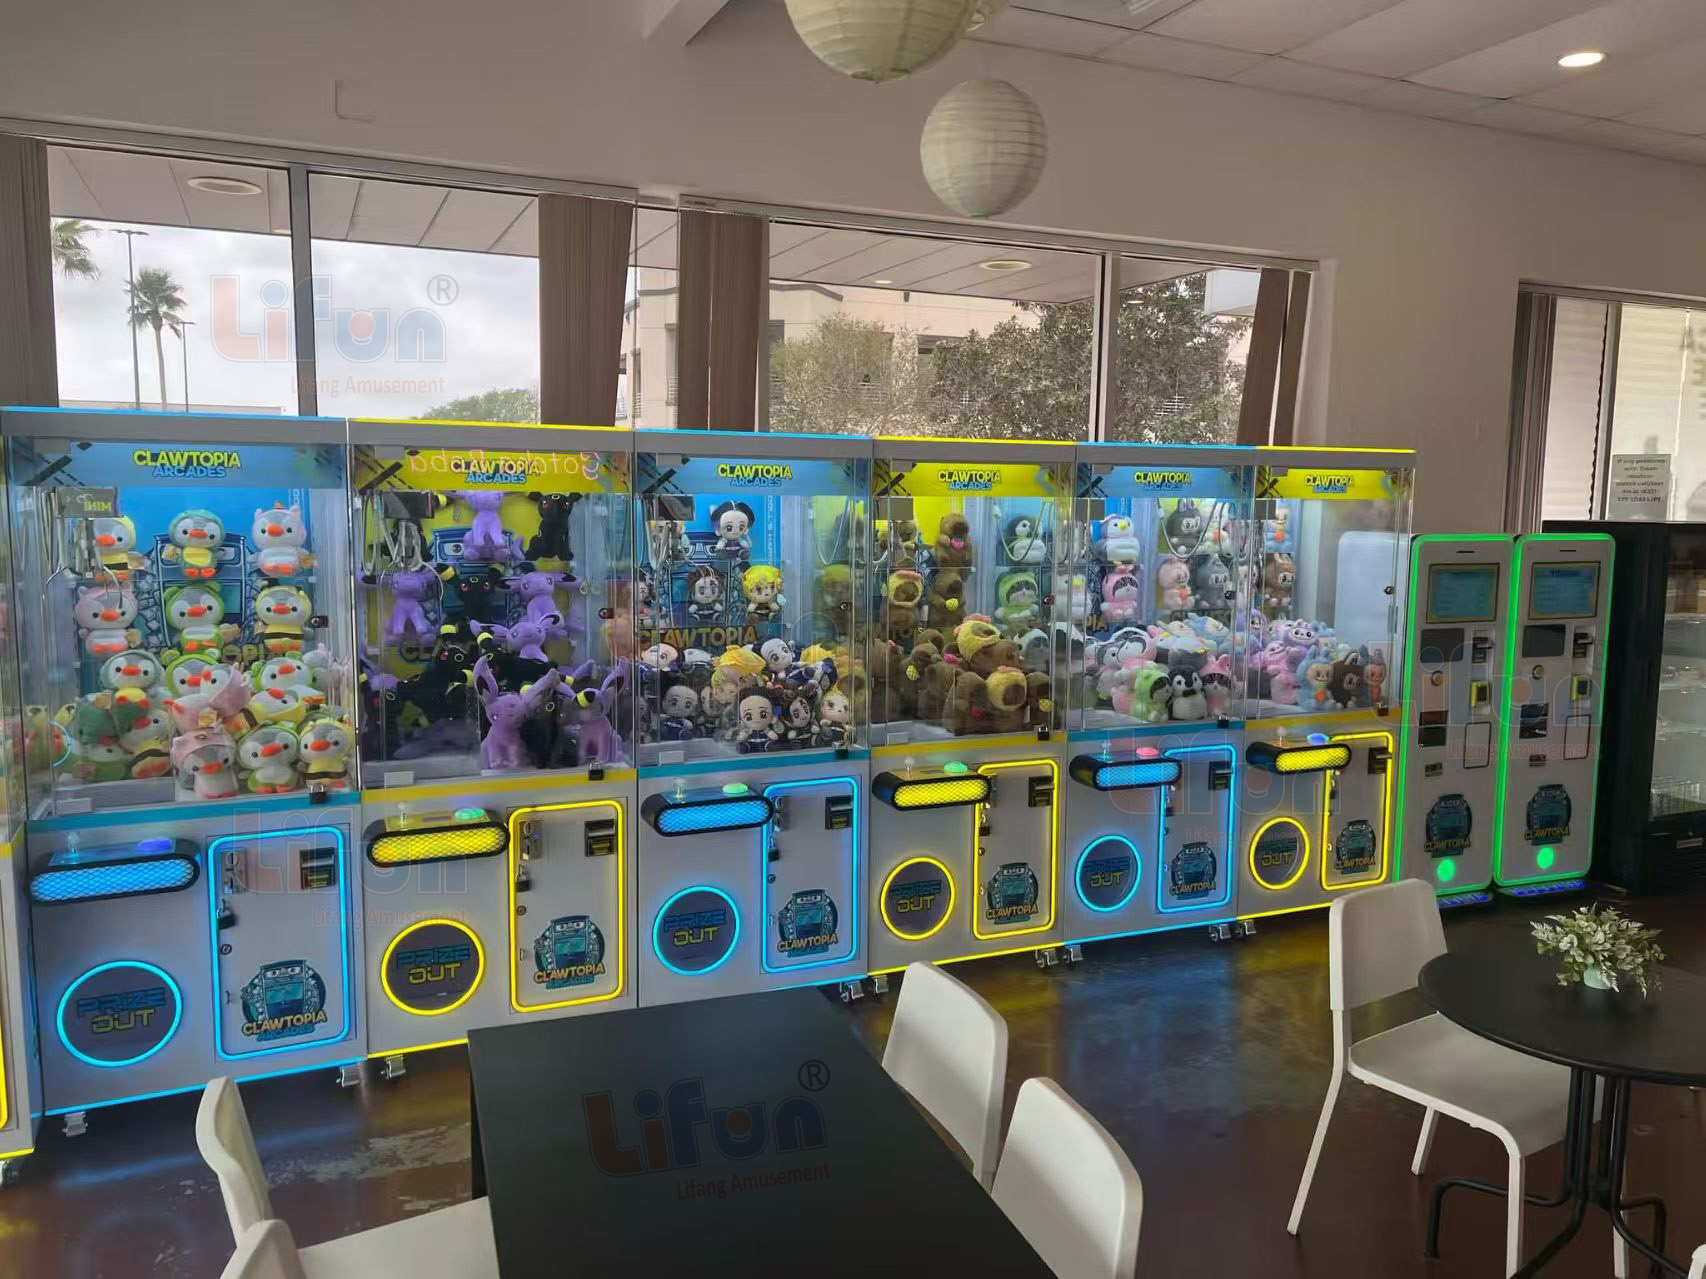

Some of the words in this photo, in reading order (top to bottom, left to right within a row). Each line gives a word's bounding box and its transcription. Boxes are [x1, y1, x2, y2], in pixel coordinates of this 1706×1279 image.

[133, 449, 242, 467] CLAWTOPIA
[450, 456, 541, 474] CLAWTOPIA
[152, 465, 226, 478] ARCADES
[465, 472, 528, 484] ARCADES
[717, 463, 793, 480] CLAWTOPIA
[937, 470, 1002, 484] CLAWTOPIA
[1133, 471, 1191, 484] CLAWTOPIA
[730, 477, 783, 489] ARCADES
[948, 481, 994, 492] ARCADES
[1304, 474, 1355, 487] CLAWTOPIA
[1524, 826, 1571, 841] CLAWTOPIA
[1169, 881, 1217, 895] CLAWTOPIA
[896, 895, 935, 913] OUT
[986, 904, 1038, 920] CLAWTOPIA
[673, 927, 718, 947] OUT
[777, 933, 838, 953] CLAWTOPIA
[396, 944, 470, 968] PRIZE
[408, 962, 461, 984] OUT
[534, 963, 606, 984] CLAWTOPIA
[76, 987, 166, 1018] PRIZE
[91, 1007, 156, 1034] OUT
[242, 1009, 327, 1036] CLAWTOPIA
